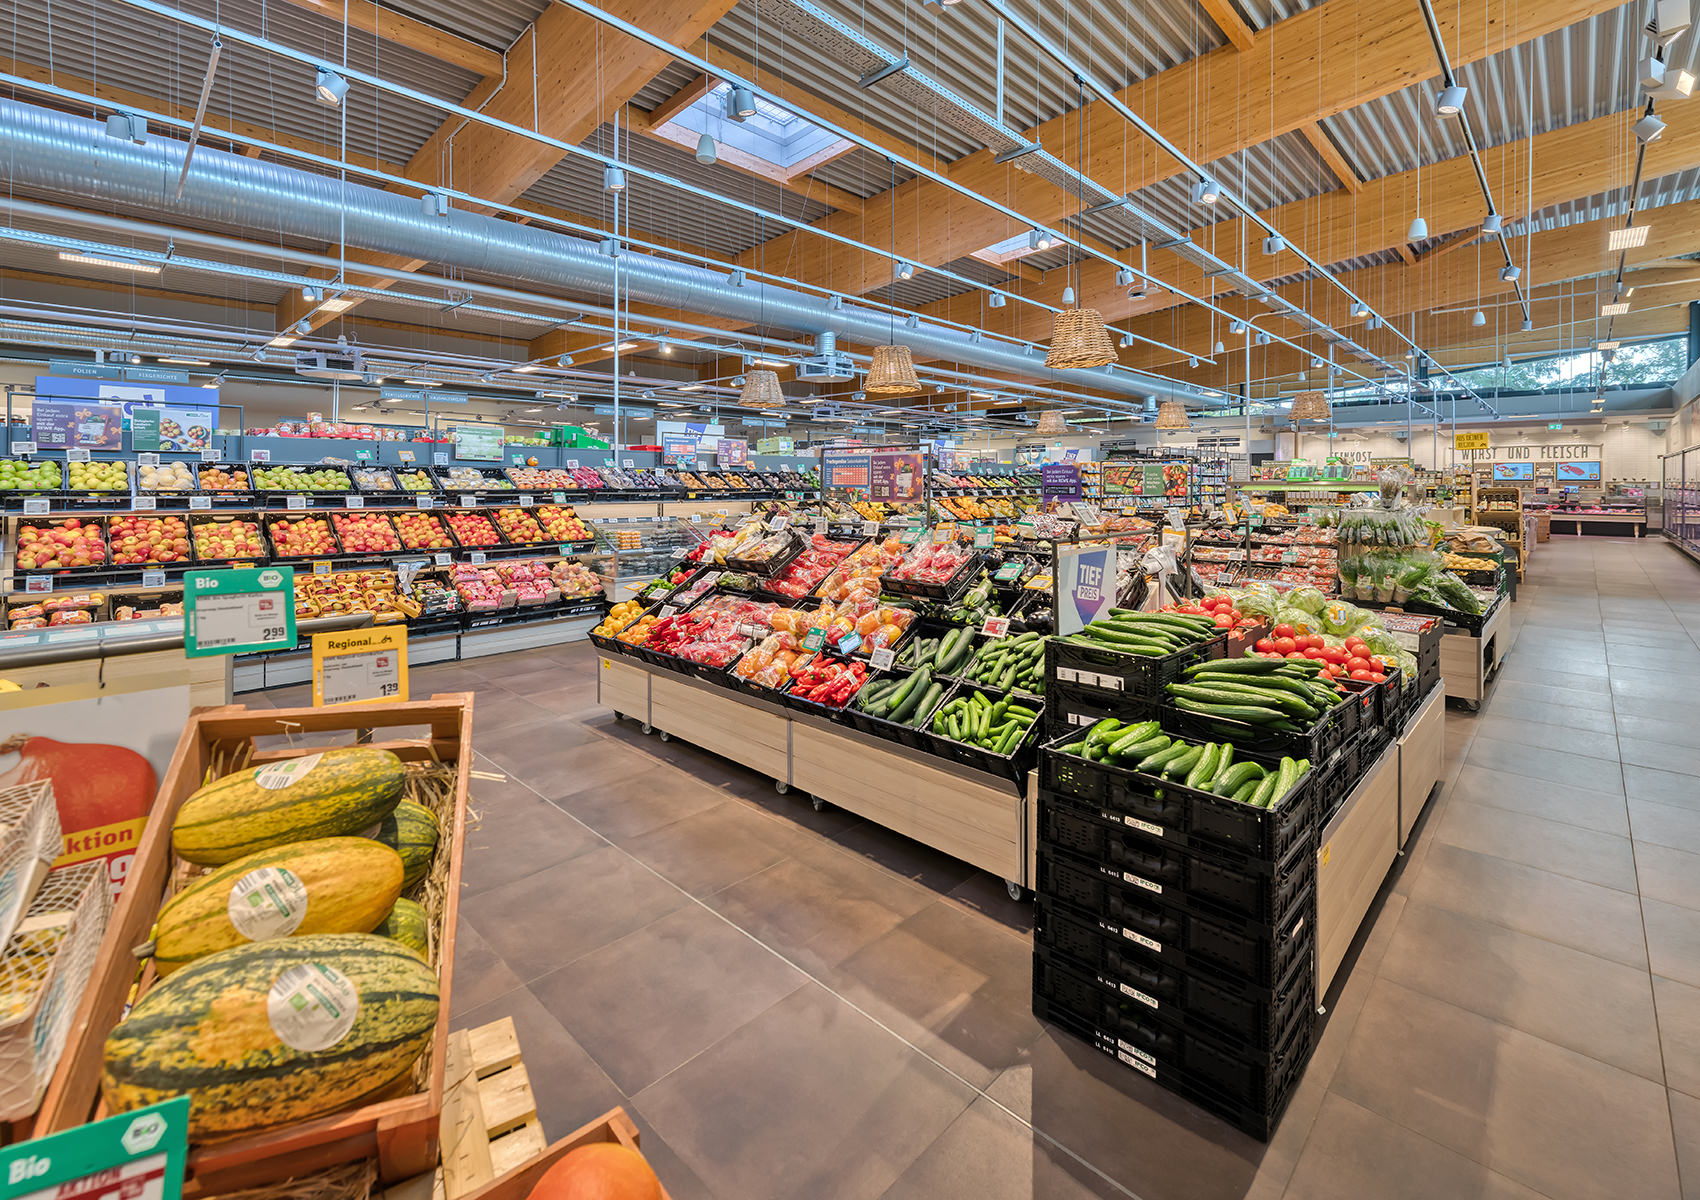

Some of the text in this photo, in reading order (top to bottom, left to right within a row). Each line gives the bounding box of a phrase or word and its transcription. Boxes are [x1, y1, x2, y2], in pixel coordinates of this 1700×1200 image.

[1462, 446, 1588, 460] WURST UND FLEISCH
[1080, 564, 1102, 586] TIEF
[195, 577, 219, 589] Bio
[1080, 587, 1097, 599] PREIS
[263, 627, 285, 640] 2.99
[328, 637, 371, 650] Regional
[380, 683, 398, 696] 1.39
[67, 829, 132, 855] ktion
[8, 1154, 51, 1185] Bio
